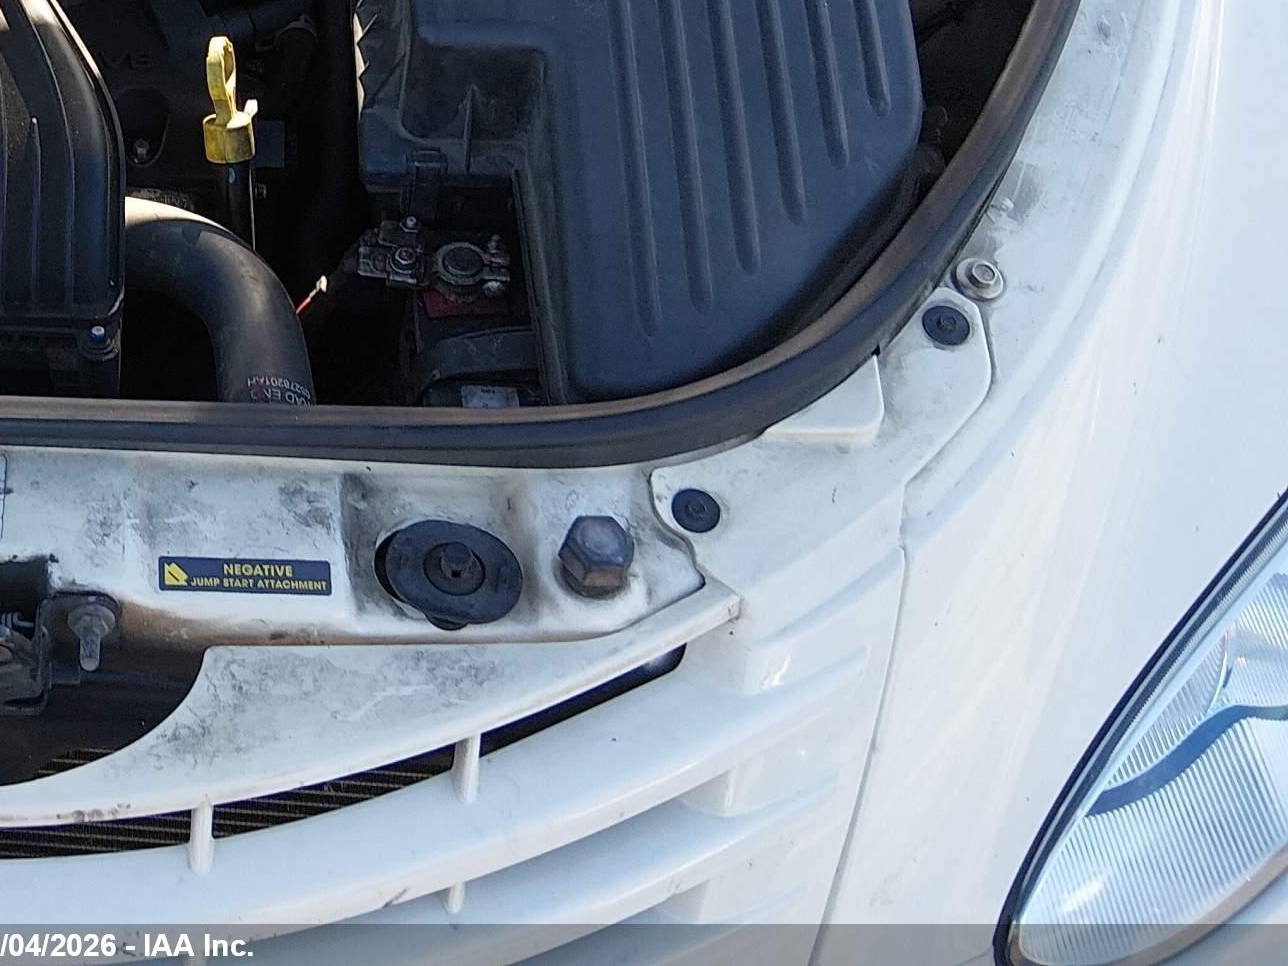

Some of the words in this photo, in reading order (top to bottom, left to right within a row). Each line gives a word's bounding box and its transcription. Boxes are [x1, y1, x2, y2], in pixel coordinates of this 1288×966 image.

[223, 563, 293, 577] NEGATIVE
[191, 577, 220, 587] JUMP
[223, 578, 254, 589] START
[257, 579, 327, 591] ATTACHMENT
